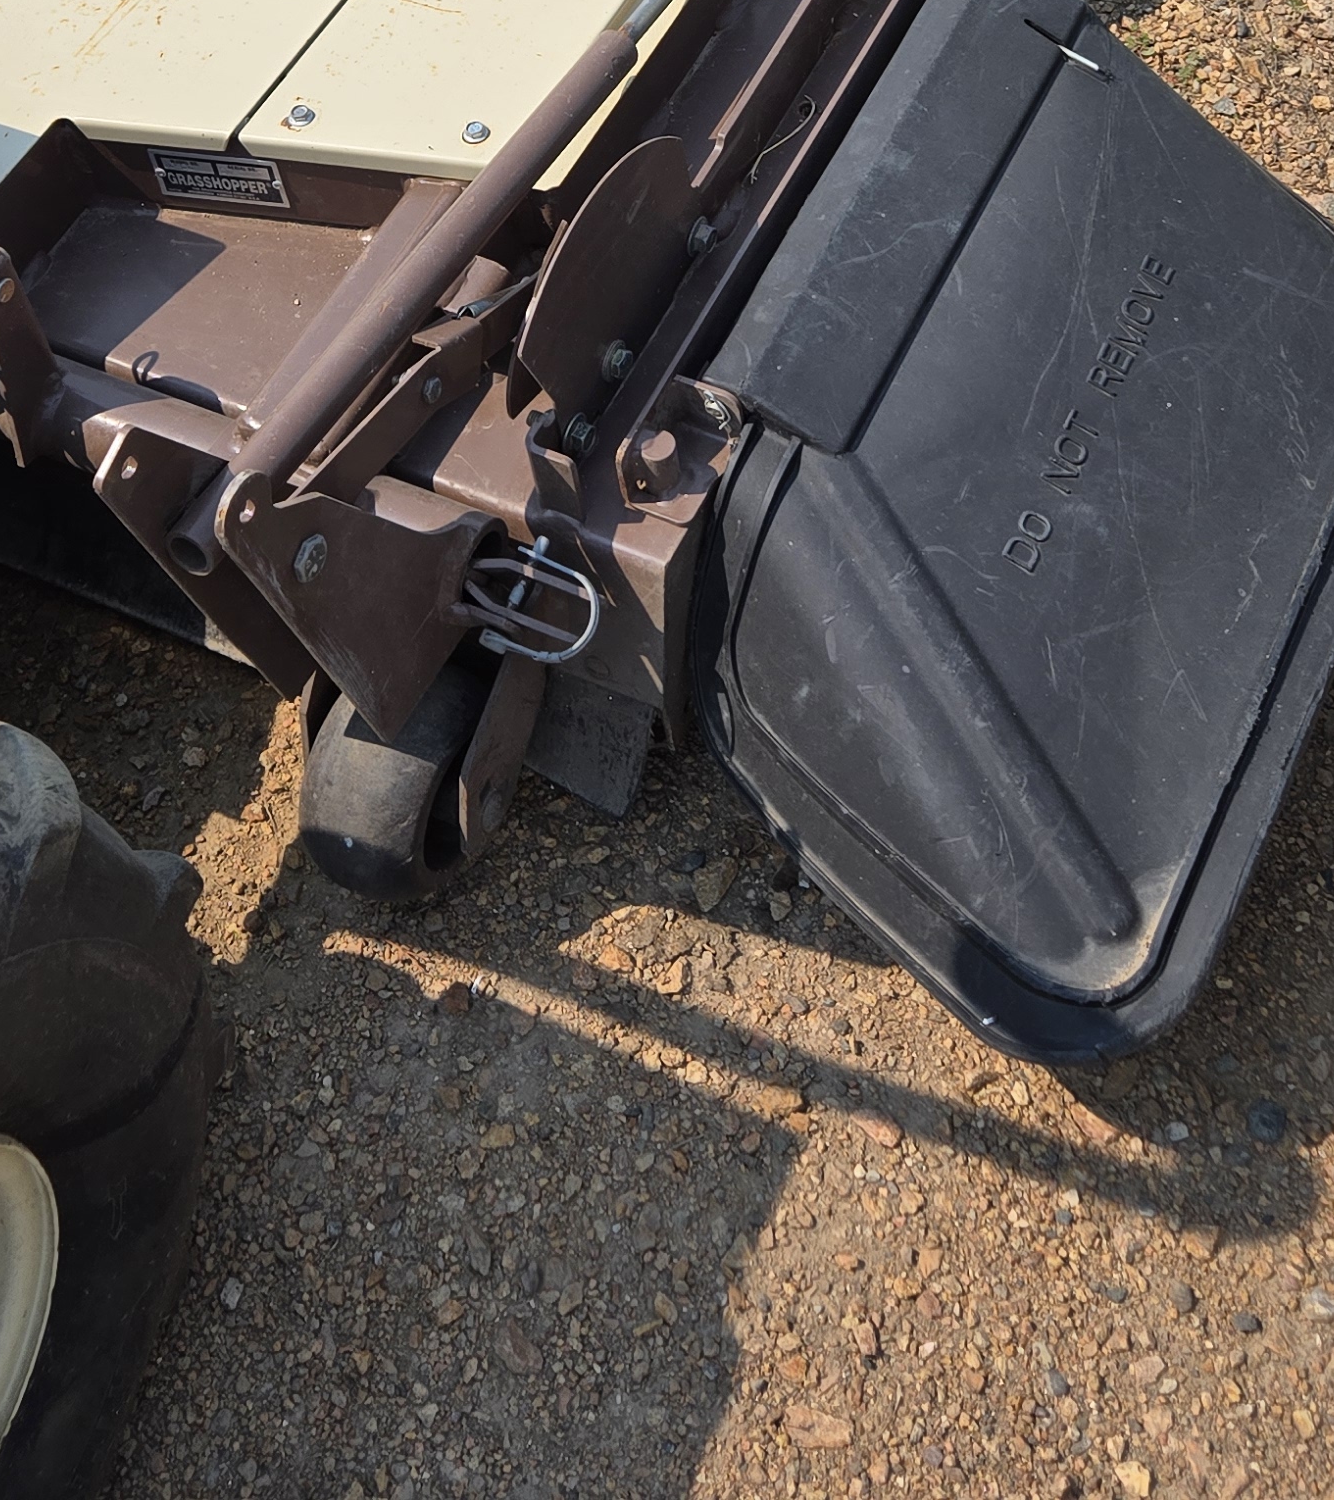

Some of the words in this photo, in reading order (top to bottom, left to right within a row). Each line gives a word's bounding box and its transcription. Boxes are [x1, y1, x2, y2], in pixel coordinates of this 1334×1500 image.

[166, 171, 268, 194] GRASSHOPPER
[1002, 510, 1053, 576] DO
[1040, 409, 1099, 496] NOT
[1087, 254, 1176, 398] REMOVE
